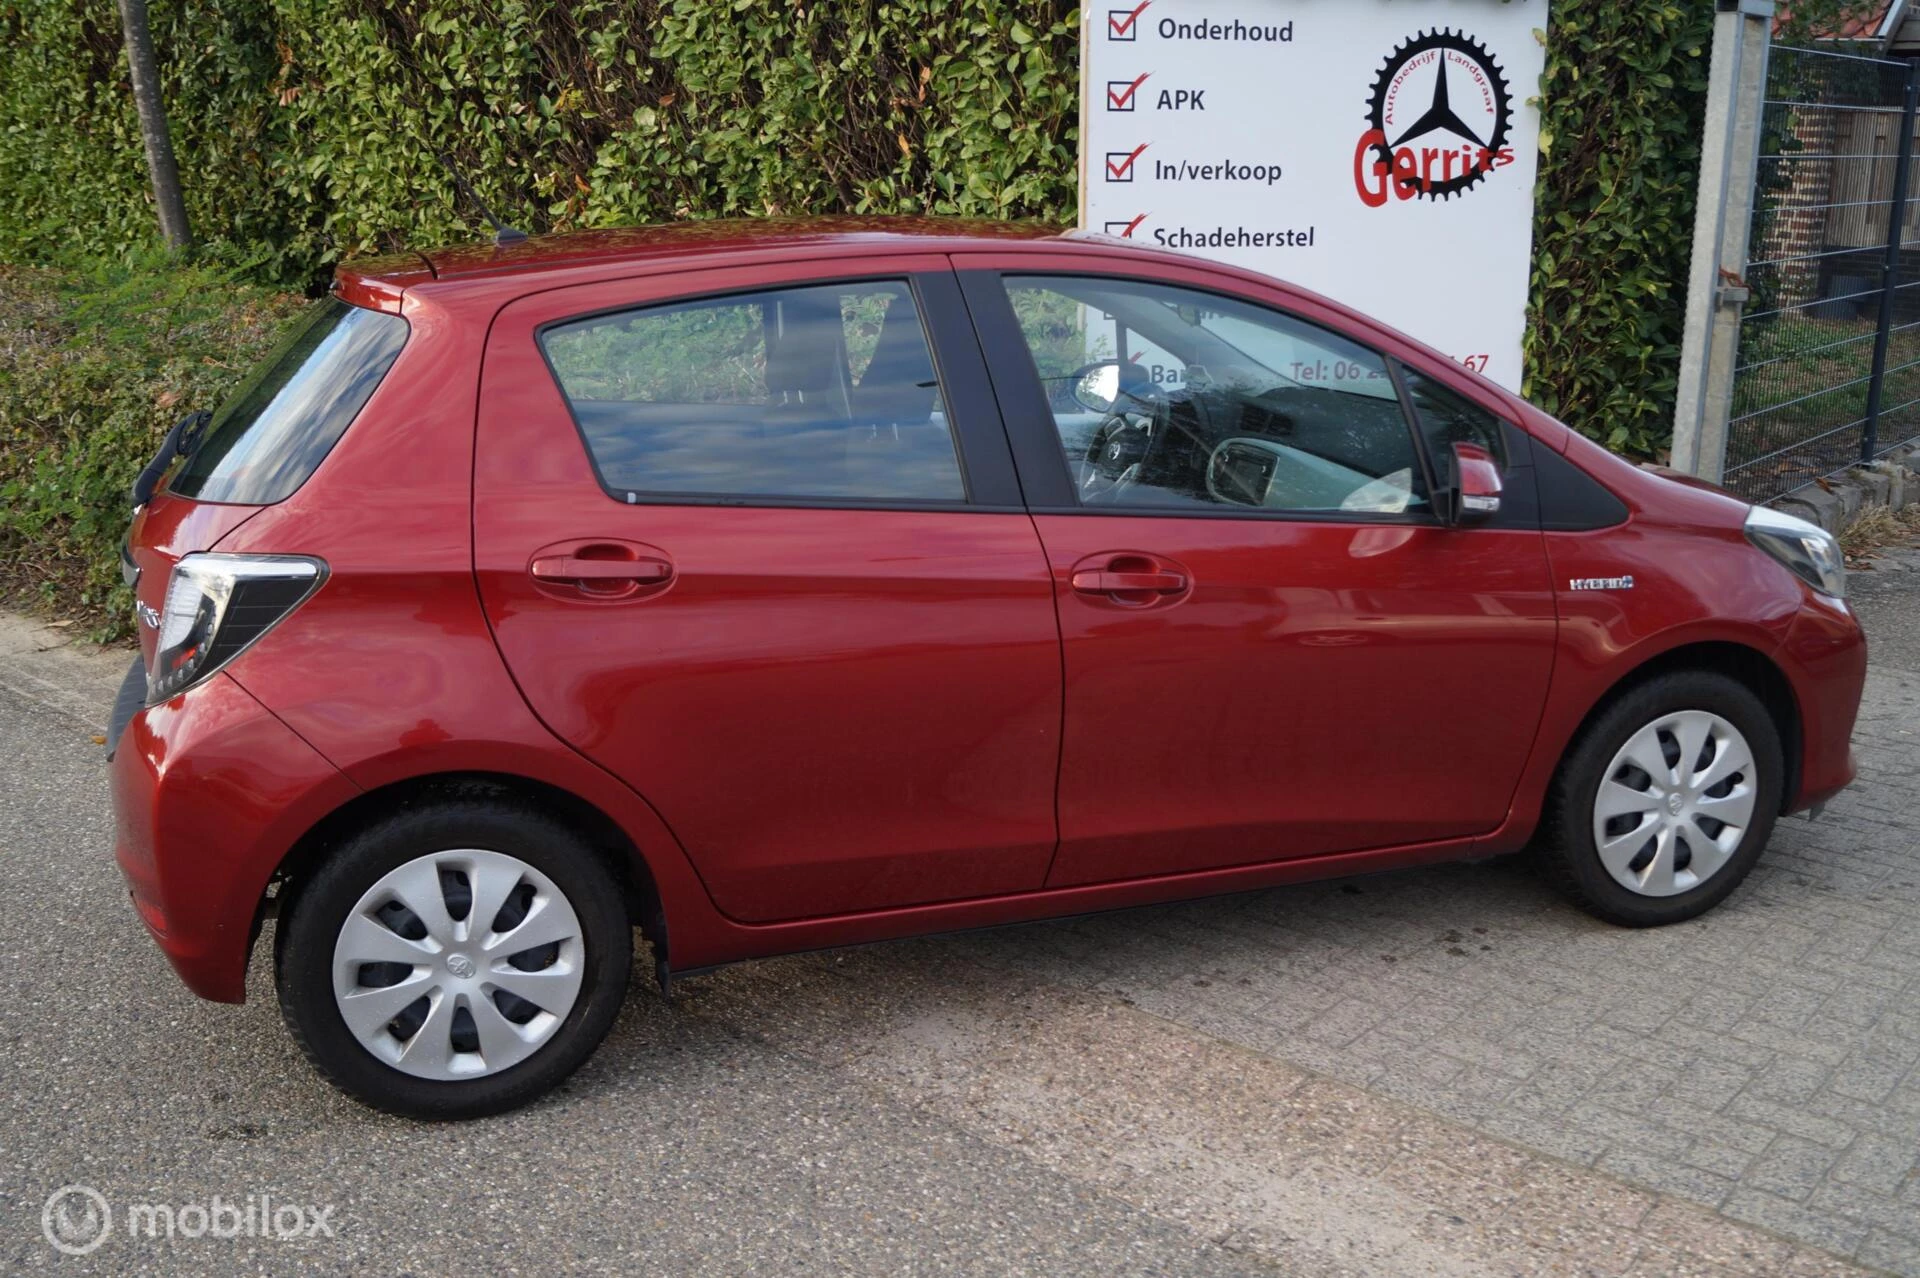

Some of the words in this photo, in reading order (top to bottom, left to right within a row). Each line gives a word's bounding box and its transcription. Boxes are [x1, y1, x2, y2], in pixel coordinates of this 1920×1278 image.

[1158, 18, 1293, 42] Onderhoud
[1156, 89, 1205, 110] APK
[1385, 51, 1436, 125] Autobedrijf
[1447, 51, 1495, 114] Landgraaf
[1155, 159, 1282, 186] In/verkoop
[1354, 128, 1515, 208] Gerrits
[1153, 226, 1315, 248] Schadeherstel
[1290, 360, 1328, 380] Tel:
[1334, 360, 1361, 380] 06
